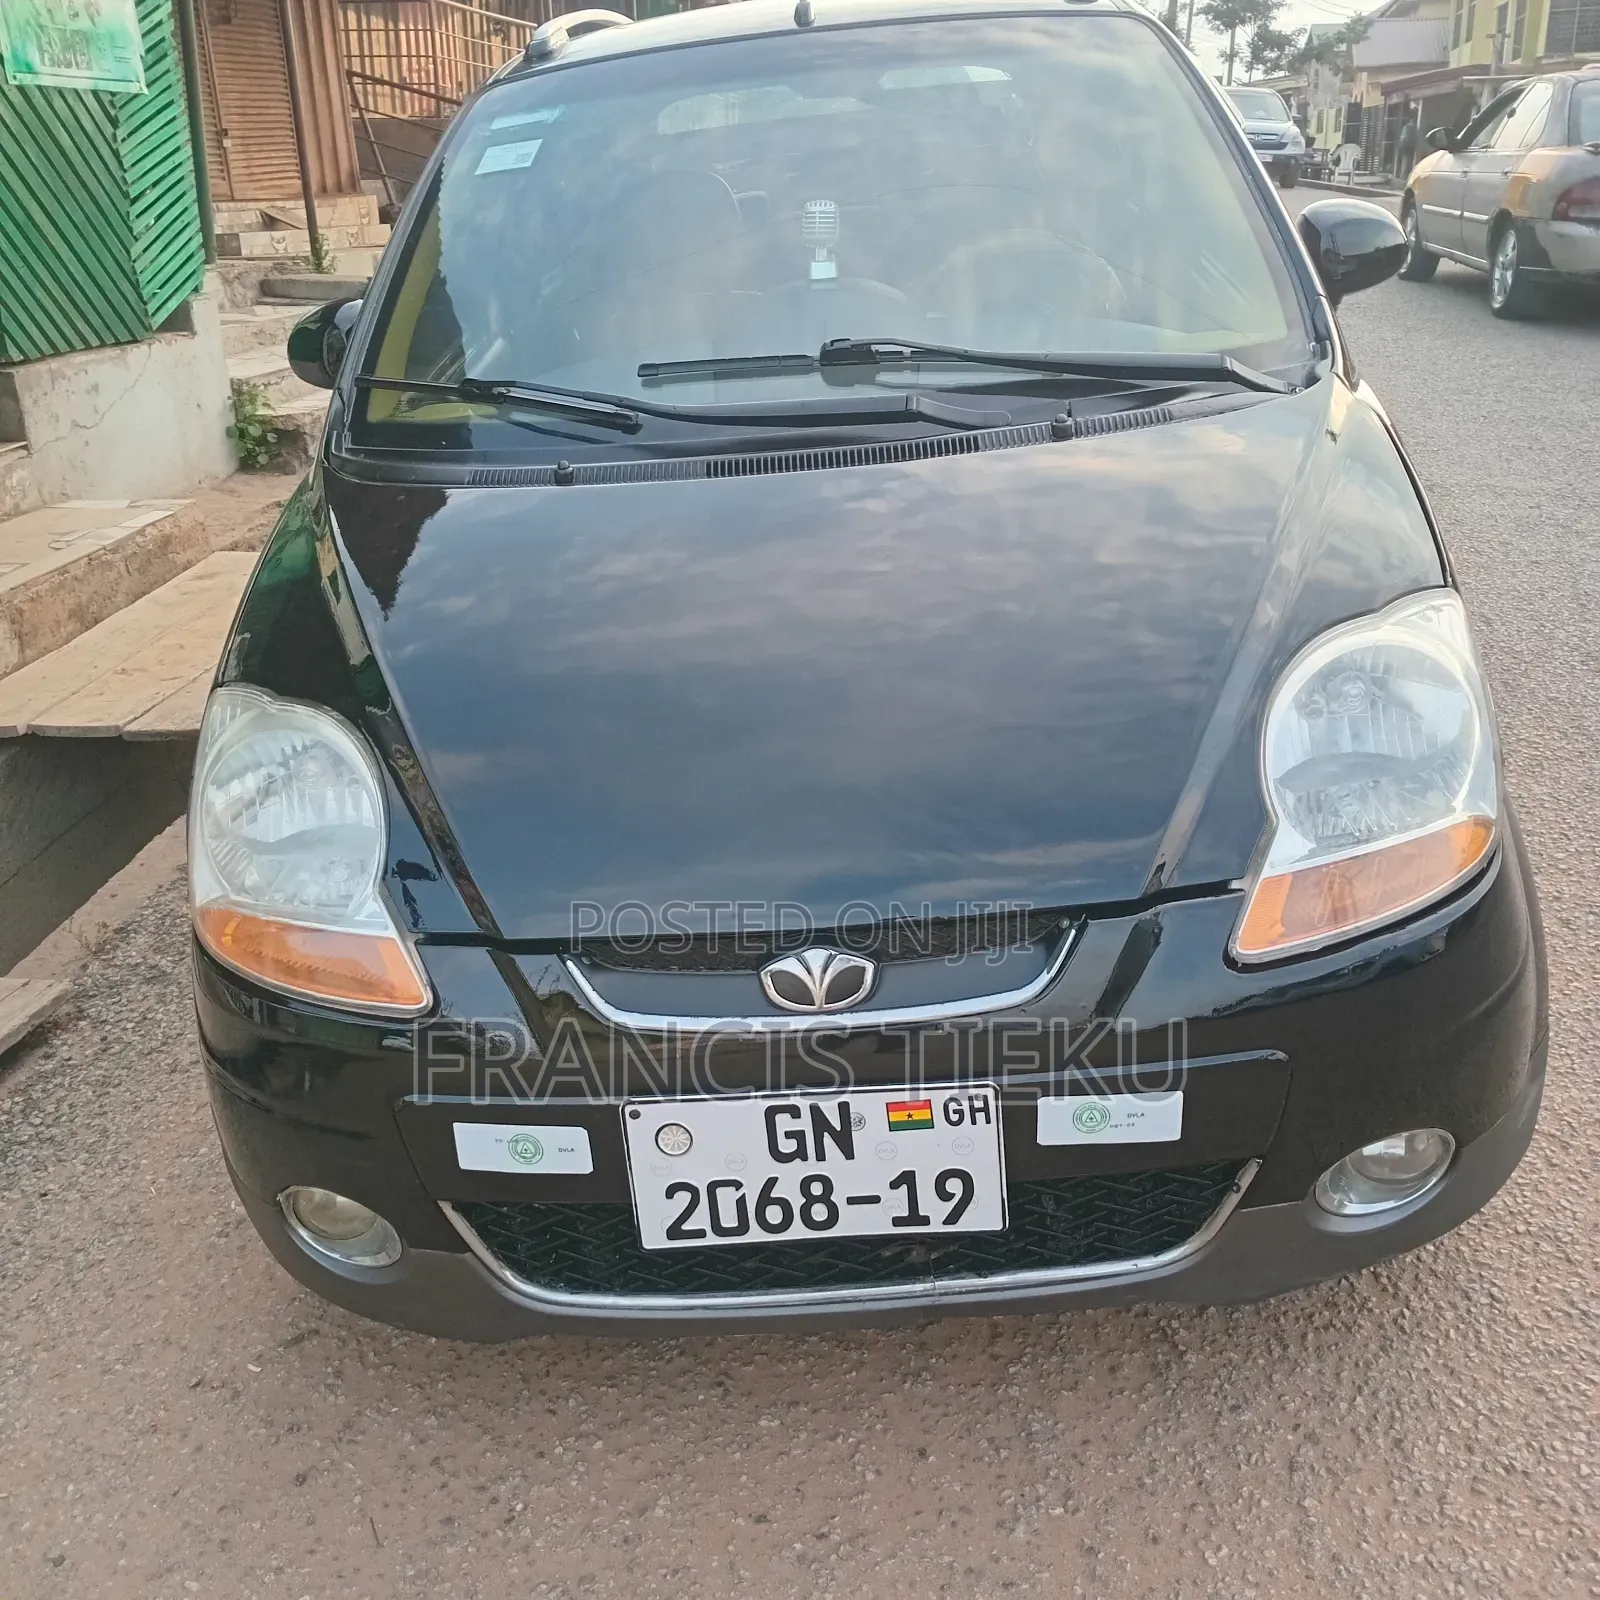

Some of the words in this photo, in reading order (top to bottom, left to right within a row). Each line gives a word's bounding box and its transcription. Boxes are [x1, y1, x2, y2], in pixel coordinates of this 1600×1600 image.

[764, 1101, 855, 1163] GN
[943, 1095, 991, 1126] GH
[665, 1167, 975, 1240] 2068-19
